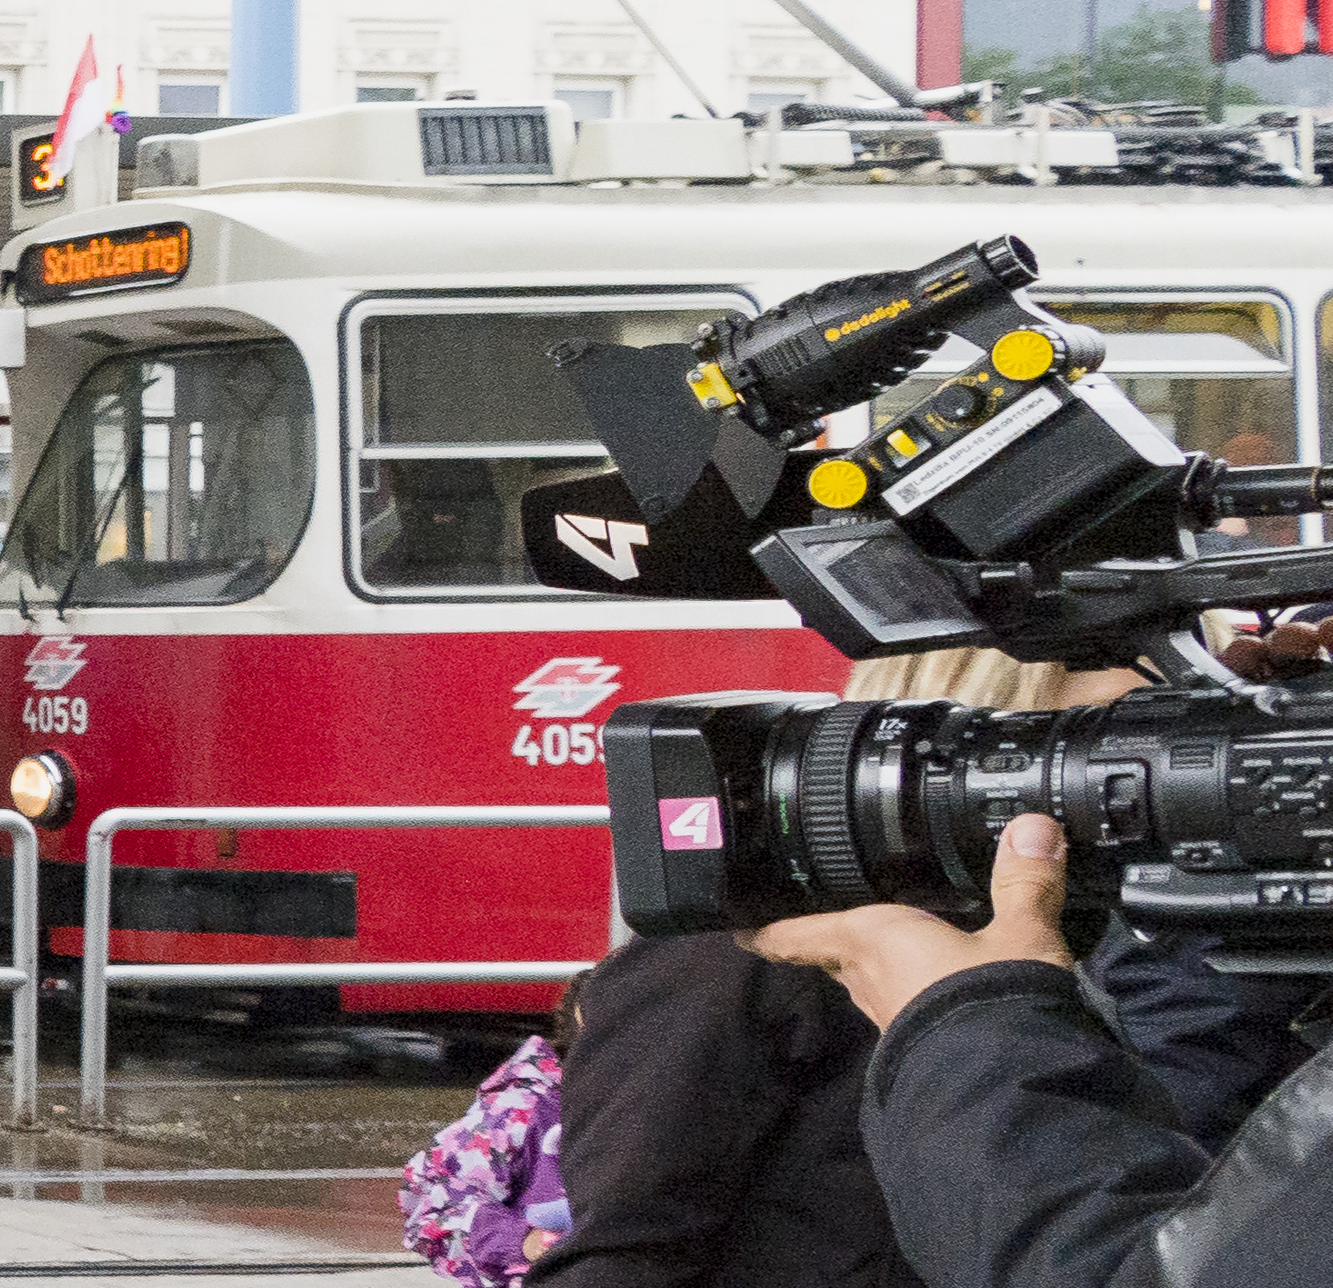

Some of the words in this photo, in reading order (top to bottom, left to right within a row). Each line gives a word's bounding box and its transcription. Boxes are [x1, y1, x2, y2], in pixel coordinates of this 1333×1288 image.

[44, 229, 181, 285] Schottenring
[22, 695, 89, 736] 4059
[510, 722, 606, 767] 405
[668, 802, 710, 844] 4
